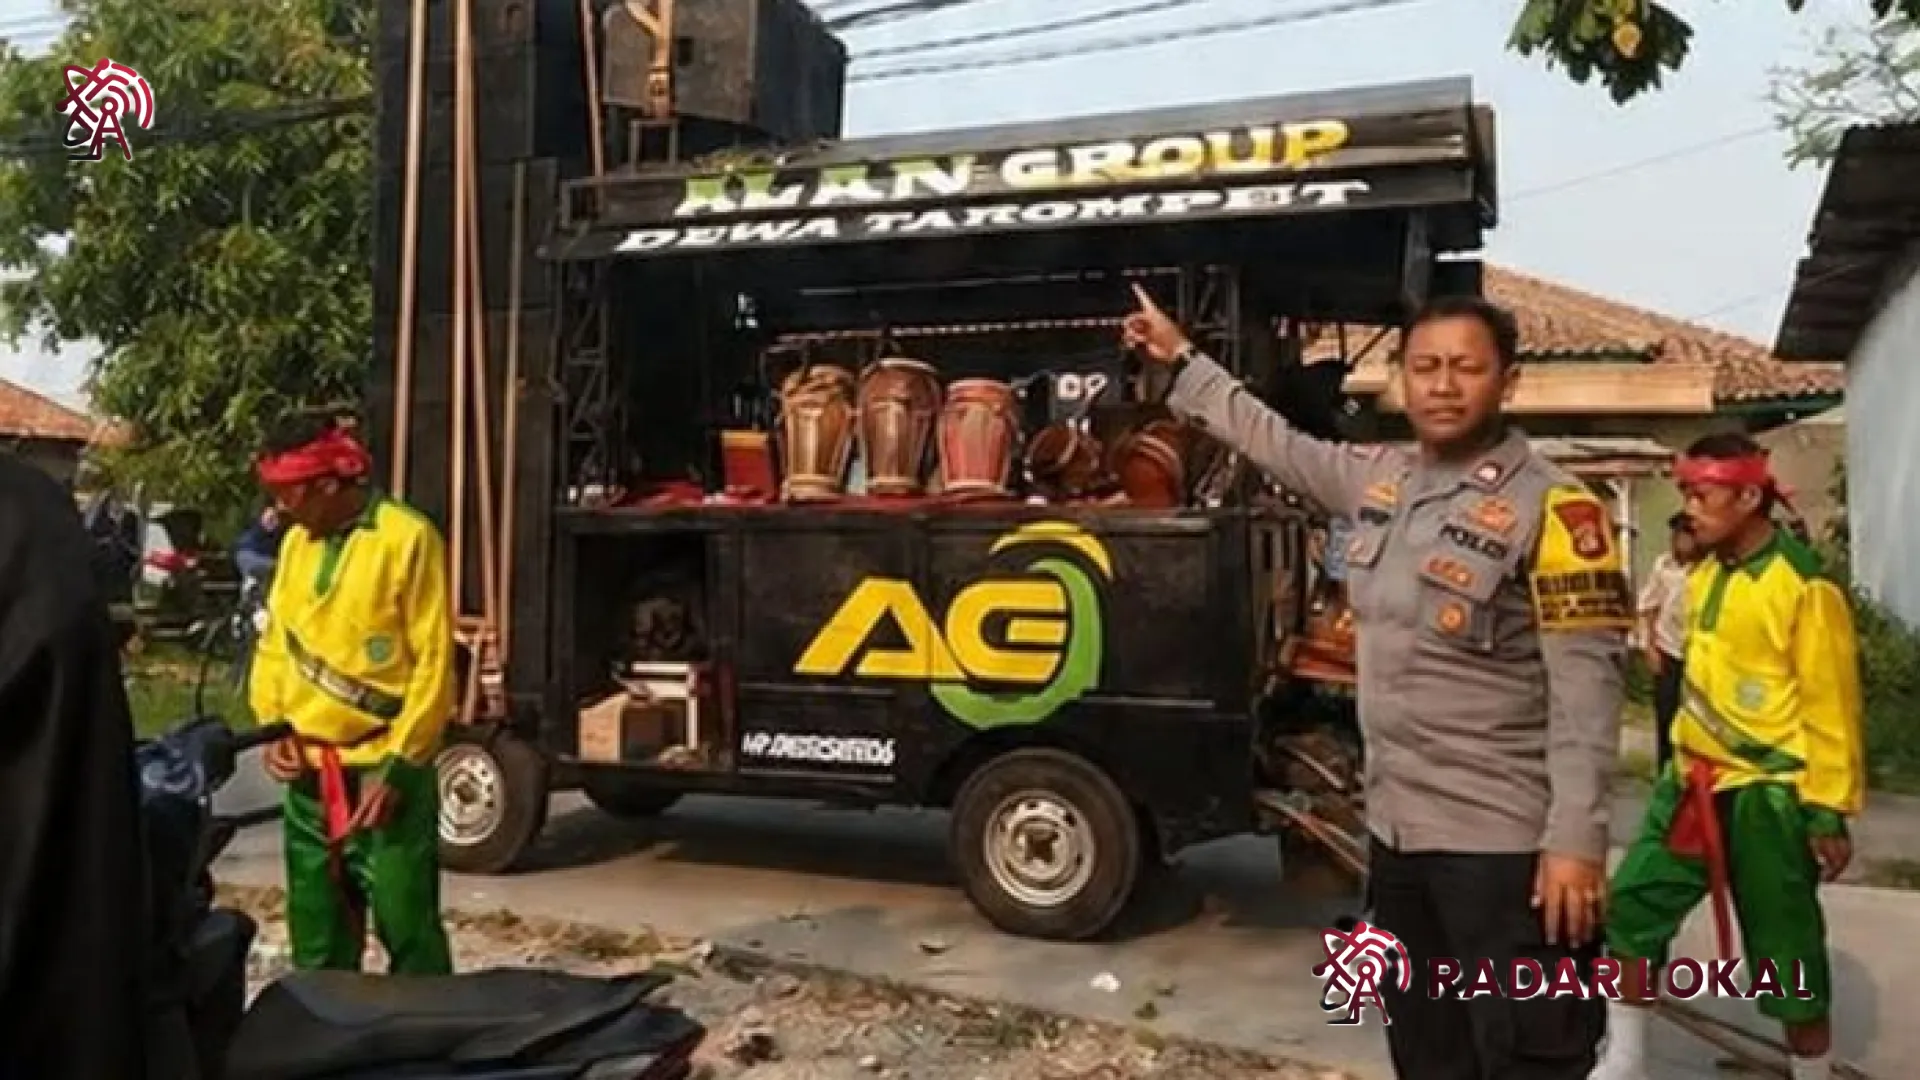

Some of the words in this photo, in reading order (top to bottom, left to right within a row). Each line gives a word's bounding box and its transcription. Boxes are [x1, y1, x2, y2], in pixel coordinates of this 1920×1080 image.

[614, 215, 838, 251] DEWA
[863, 179, 1370, 234] TAROMPET
[673, 154, 977, 217] ALAN
[1002, 120, 1349, 188] GROUP
[793, 578, 1068, 682] AG
